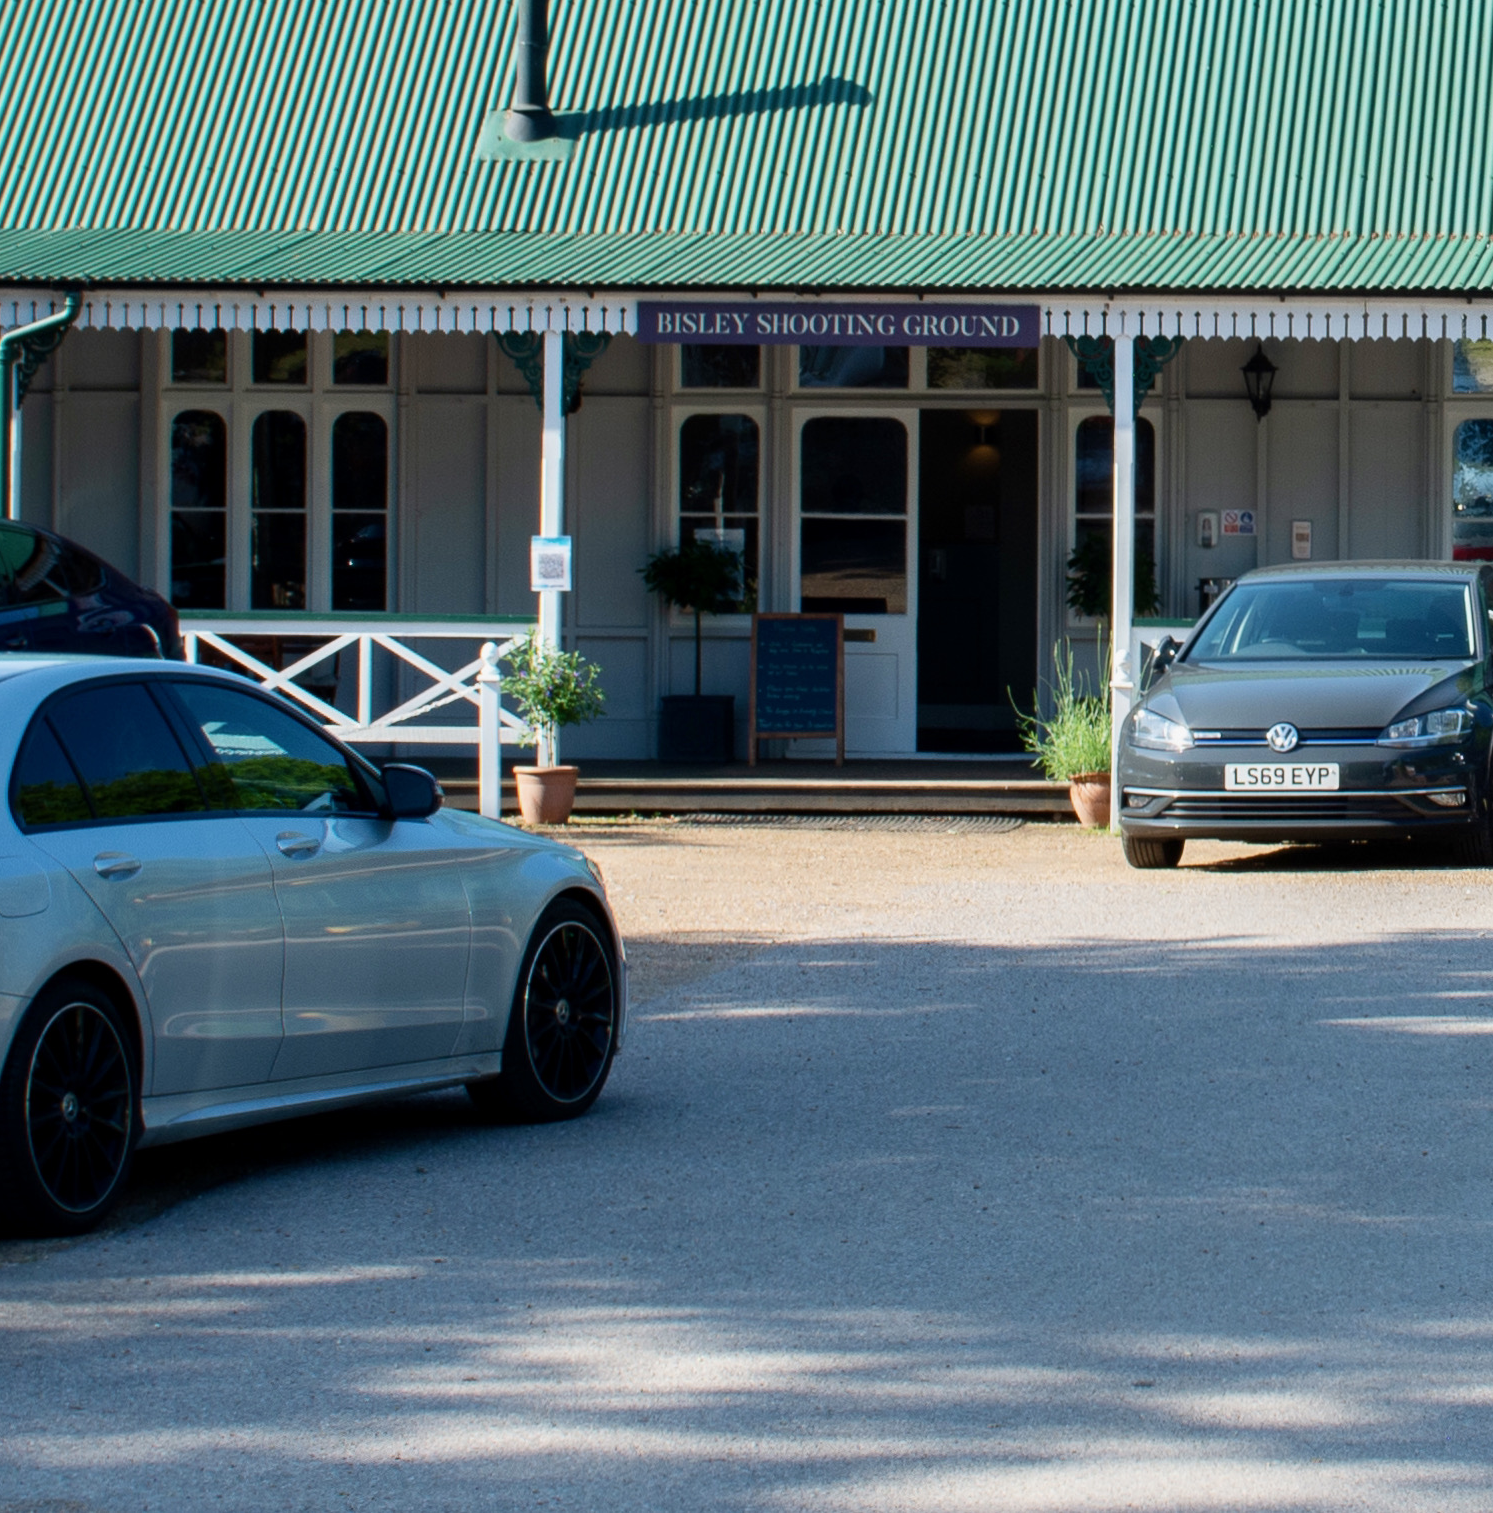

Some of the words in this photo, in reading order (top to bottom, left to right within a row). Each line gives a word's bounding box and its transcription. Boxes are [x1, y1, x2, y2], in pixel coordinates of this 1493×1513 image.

[656, 313, 749, 334] BISLEY
[756, 314, 895, 336] SHOOTING
[902, 315, 1020, 338] GROUND
[1233, 766, 1285, 786] LS69
[1291, 766, 1330, 786] EYP
